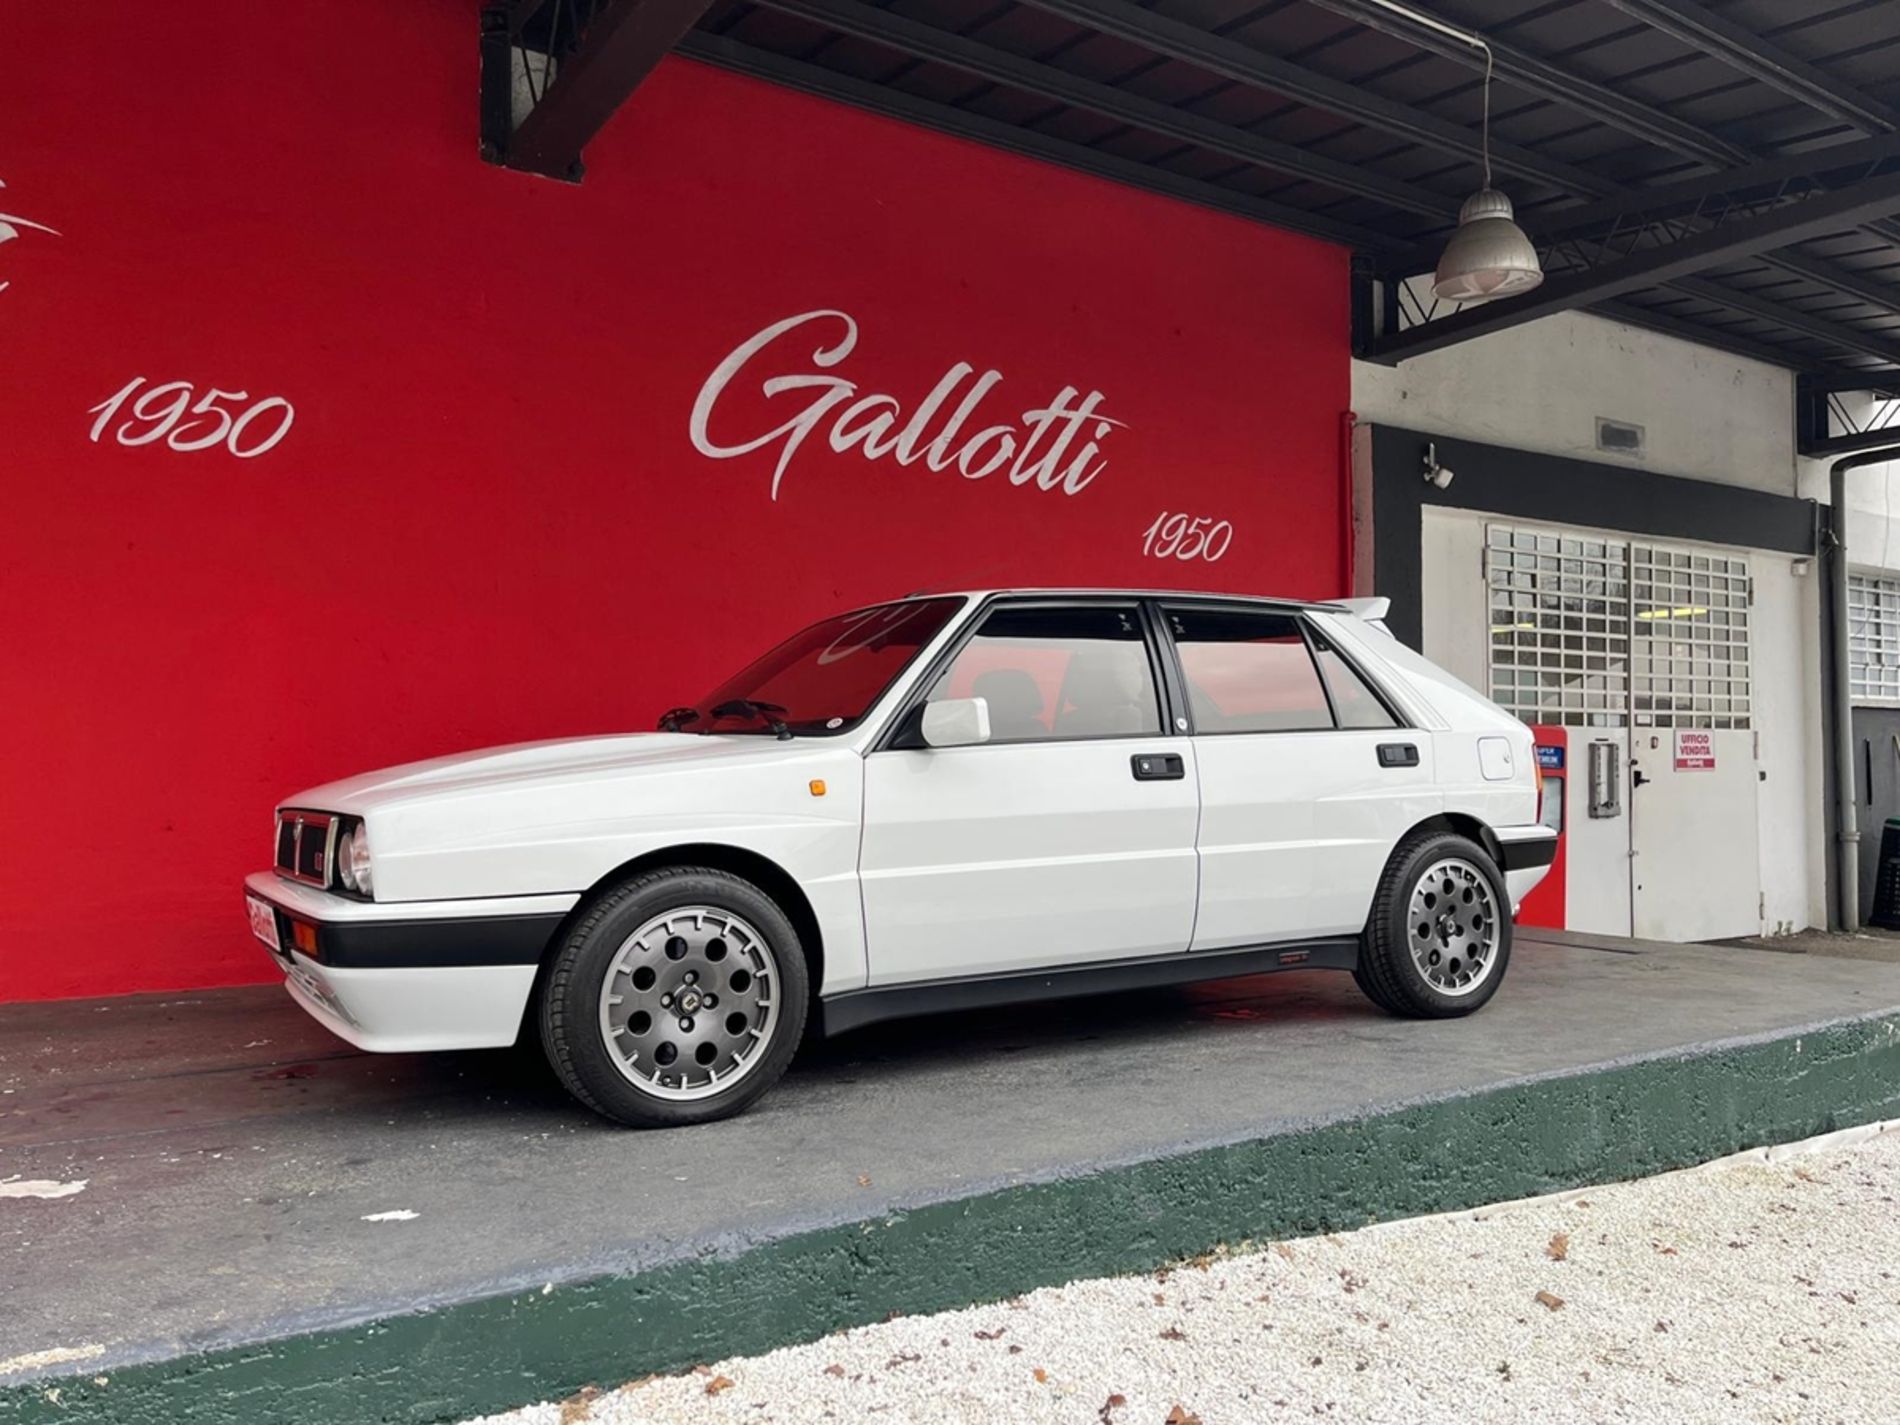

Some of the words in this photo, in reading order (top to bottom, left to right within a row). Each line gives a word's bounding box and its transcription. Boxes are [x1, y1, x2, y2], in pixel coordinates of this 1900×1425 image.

[87, 376, 294, 458] 1950
[689, 310, 1130, 501] Gallotti
[1142, 511, 1233, 562] 1950
[1679, 745, 1711, 756] VENDITA
[1681, 734, 1710, 745] UFFICIO
